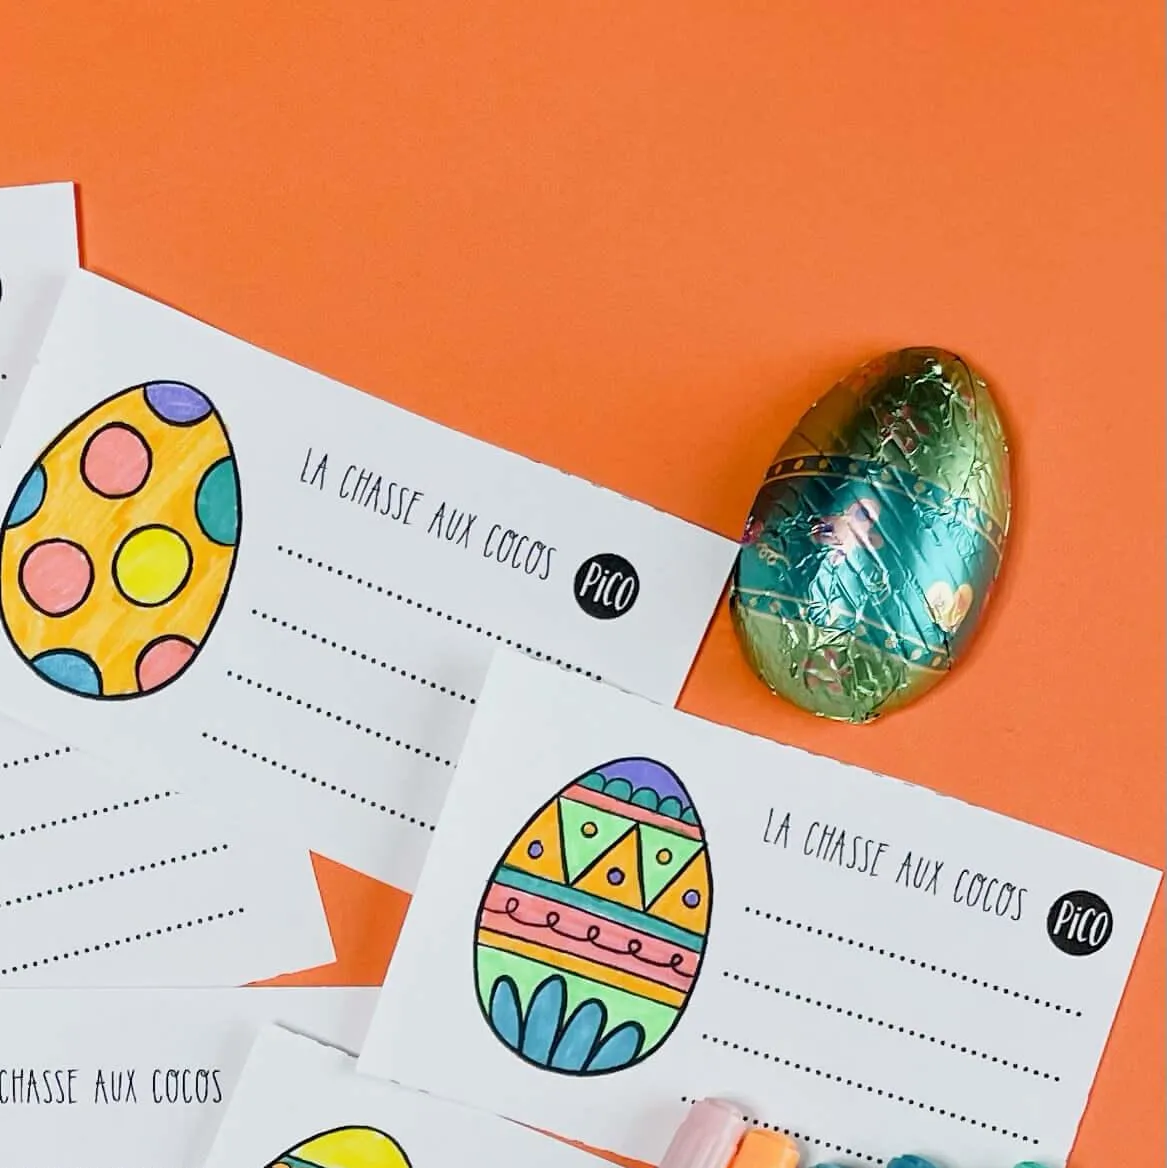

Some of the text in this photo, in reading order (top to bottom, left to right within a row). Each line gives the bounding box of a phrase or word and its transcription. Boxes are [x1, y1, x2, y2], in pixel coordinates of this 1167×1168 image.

[301, 448, 556, 580] LA CHASSE AUX COCOS
[764, 808, 1027, 920] LA CHASSE AUX COCOS
[0, 1069, 78, 1104] CHASSE
[95, 1069, 136, 1104] AUX
[153, 1069, 222, 1103] COCOS
